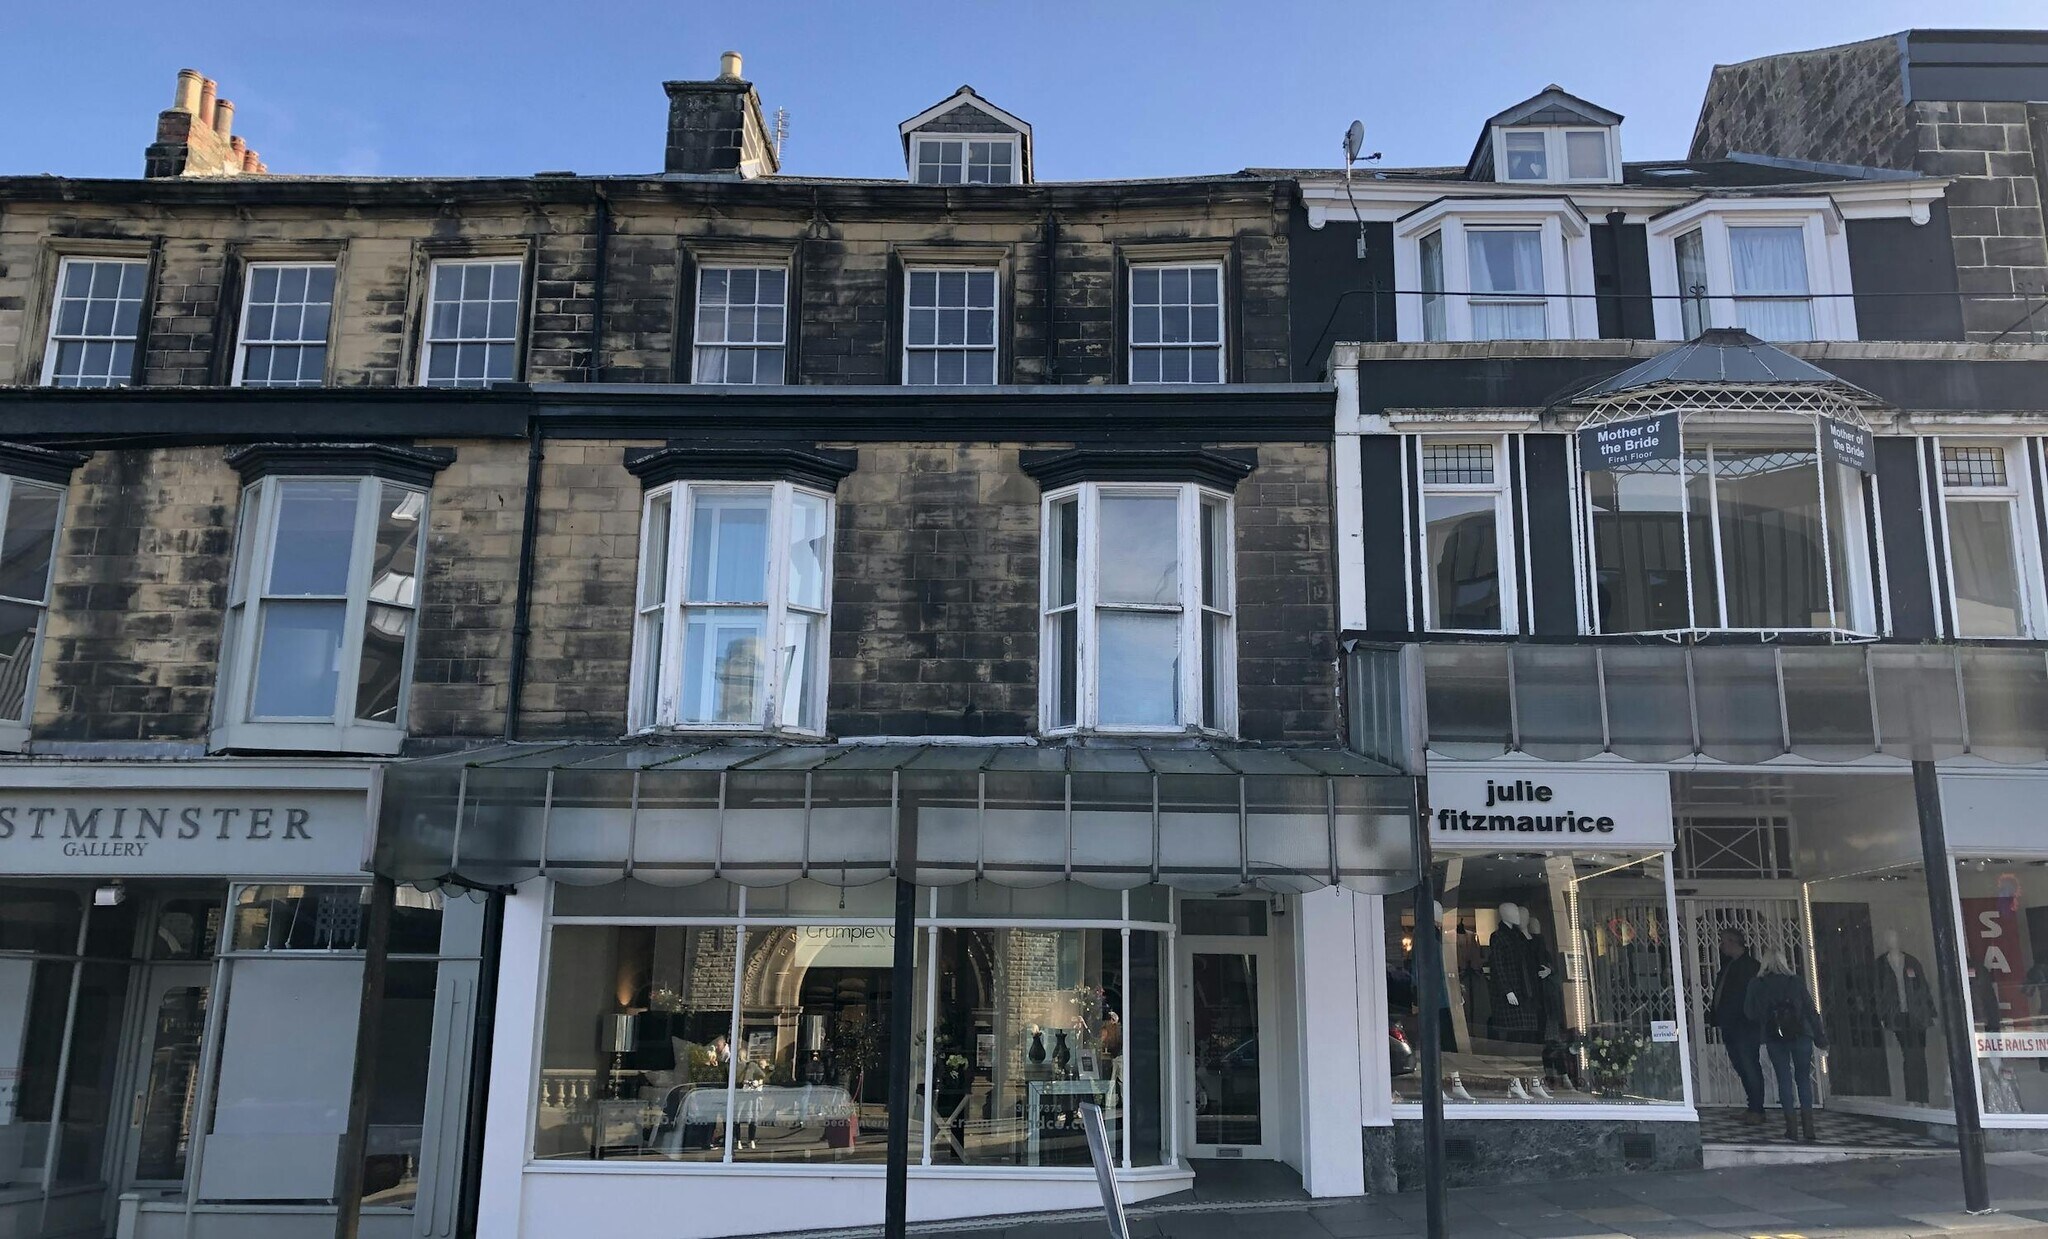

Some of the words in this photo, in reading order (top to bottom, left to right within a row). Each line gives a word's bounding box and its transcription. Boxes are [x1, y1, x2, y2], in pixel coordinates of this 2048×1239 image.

[1597, 426, 1643, 442] Mother
[1646, 421, 1660, 433] of
[1830, 424, 1854, 442] Mother
[1856, 434, 1864, 445] of
[1601, 443, 1621, 455] the
[1625, 436, 1659, 451] Bride
[1833, 438, 1845, 452] the
[1846, 442, 1865, 458] Bride
[1608, 455, 1628, 464] First
[1630, 451, 1653, 460] Floor
[1485, 780, 1553, 807] julie
[0, 807, 313, 840] STMINSTER
[1437, 808, 1615, 833] fitzmaurice
[63, 841, 149, 858] GALLERY
[806, 925, 875, 943] Crumple
[1977, 1038, 2003, 1051] SALE
[2005, 1038, 2034, 1051] RAILS
[2035, 1038, 2048, 1051] IN
